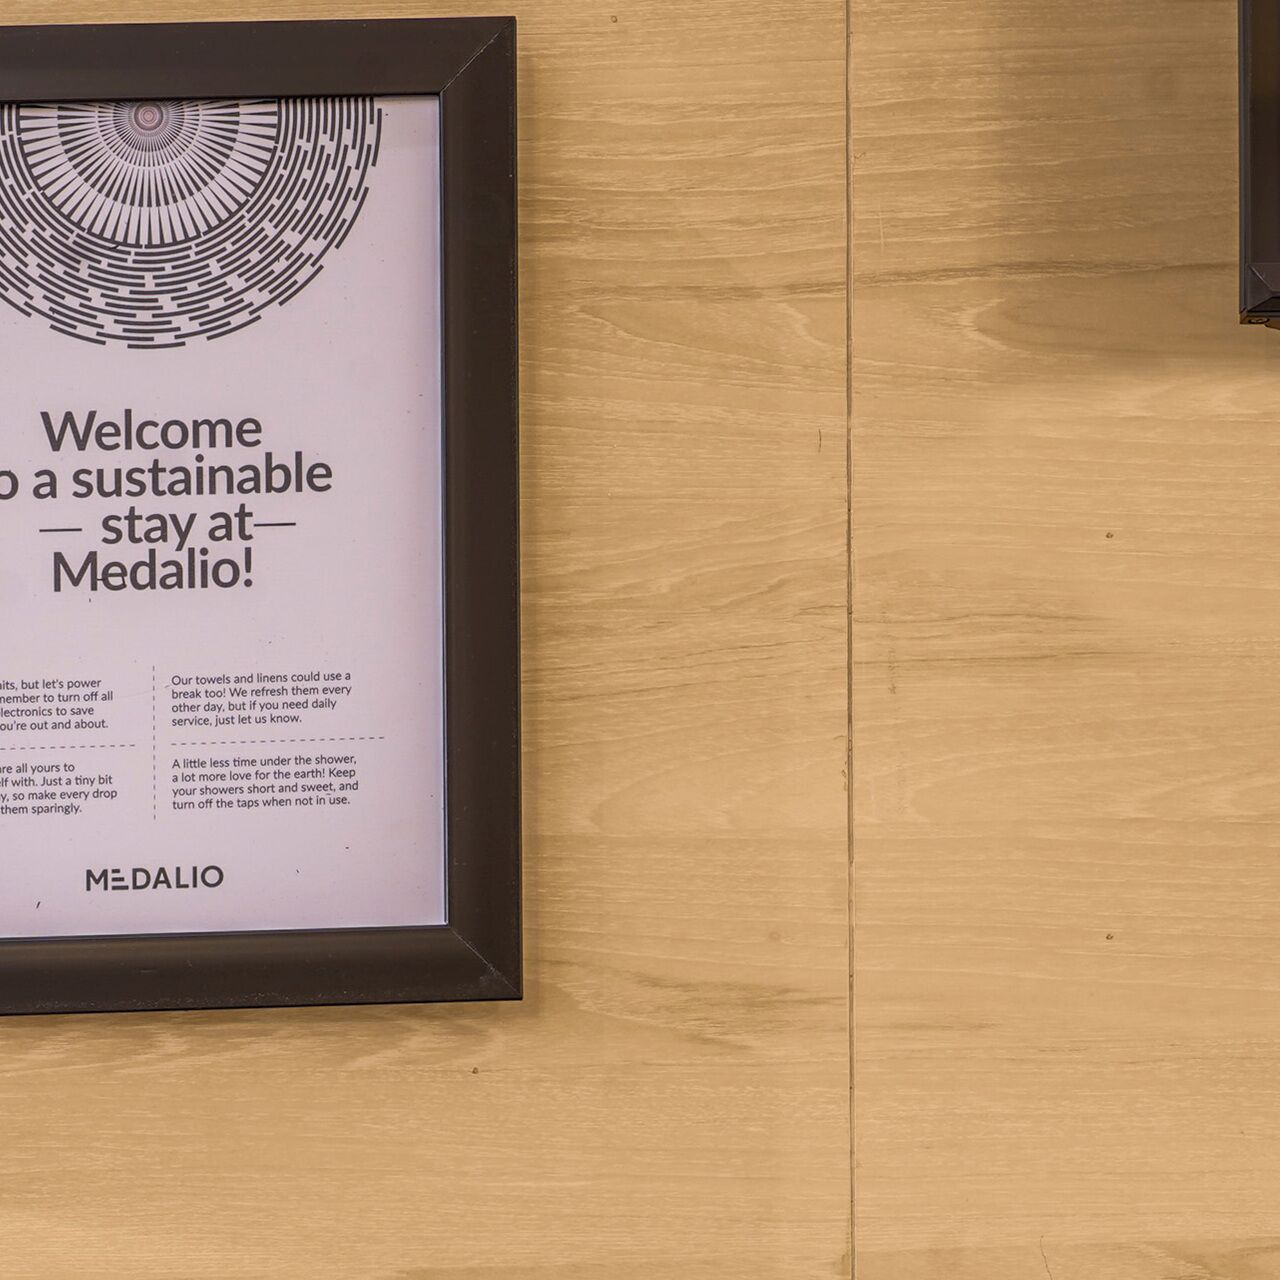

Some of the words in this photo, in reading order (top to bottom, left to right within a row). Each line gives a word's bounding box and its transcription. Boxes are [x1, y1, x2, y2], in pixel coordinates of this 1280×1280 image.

[40, 409, 262, 451] Welcome
[33, 470, 57, 499] a
[72, 452, 332, 498] sustainable
[102, 506, 197, 551] stay
[208, 503, 253, 541] at
[54, 547, 252, 592] Medalio!
[21, 680, 39, 689] but
[67, 680, 101, 690] power
[171, 675, 192, 686] Our
[196, 674, 231, 685] towels
[234, 673, 253, 684] and
[257, 673, 288, 683] linens
[291, 672, 320, 682] could
[324, 673, 342, 681] use
[43, 694, 54, 702] to
[58, 693, 80, 702] turn
[83, 691, 98, 702] off
[101, 691, 113, 701] all
[172, 688, 201, 699] break
[205, 688, 226, 698] too!
[229, 688, 247, 697] We
[251, 686, 288, 696] refresh
[291, 686, 319, 696] them
[322, 686, 352, 696] every
[56, 707, 67, 716] to
[70, 707, 94, 715] save
[172, 702, 200, 712] other
[204, 702, 224, 713] day,
[228, 701, 246, 711] but
[250, 700, 256, 710] if
[259, 702, 278, 712] you
[282, 699, 308, 709] need
[312, 698, 336, 710] daily
[30, 721, 48, 730] out
[51, 719, 71, 730] and
[74, 719, 108, 729] about.
[172, 716, 212, 726] service,
[215, 715, 235, 727] just
[238, 714, 252, 724] let
[255, 716, 267, 724] us
[270, 714, 302, 723] know.
[172, 759, 180, 768] A
[183, 758, 206, 768] little
[210, 758, 230, 768] less
[233, 757, 256, 767] time
[260, 756, 291, 766] under
[294, 755, 312, 765] the
[315, 754, 356, 764] shower,
[16, 763, 27, 773] all
[30, 765, 60, 775] yours
[64, 763, 75, 772] to
[172, 775, 178, 783] a
[182, 772, 196, 782] lot
[230, 770, 252, 781] love
[255, 770, 270, 780] for
[273, 770, 291, 780] the
[294, 768, 325, 779] earth!
[329, 768, 356, 779] Keep
[11, 776, 38, 787] with.
[41, 776, 62, 786] Just
[75, 775, 96, 786] tiny
[98, 774, 112, 784] bit
[12, 793, 24, 801] so
[28, 790, 56, 800] make
[60, 791, 90, 800] every
[92, 788, 117, 800] drop
[172, 788, 197, 798] your
[200, 785, 244, 796] showers
[248, 784, 275, 794] short
[278, 782, 298, 793] and
[301, 782, 336, 794] sweet,
[339, 780, 358, 791] and
[0, 804, 28, 814] them
[32, 803, 82, 815] sparingly.
[173, 801, 195, 810] turn
[198, 798, 213, 809] off
[216, 798, 234, 808] the
[237, 799, 259, 809] taps
[262, 796, 292, 806] when
[295, 796, 313, 806] not
[316, 795, 325, 805] in
[329, 796, 350, 805] use.
[86, 865, 224, 891] MEDALIO
